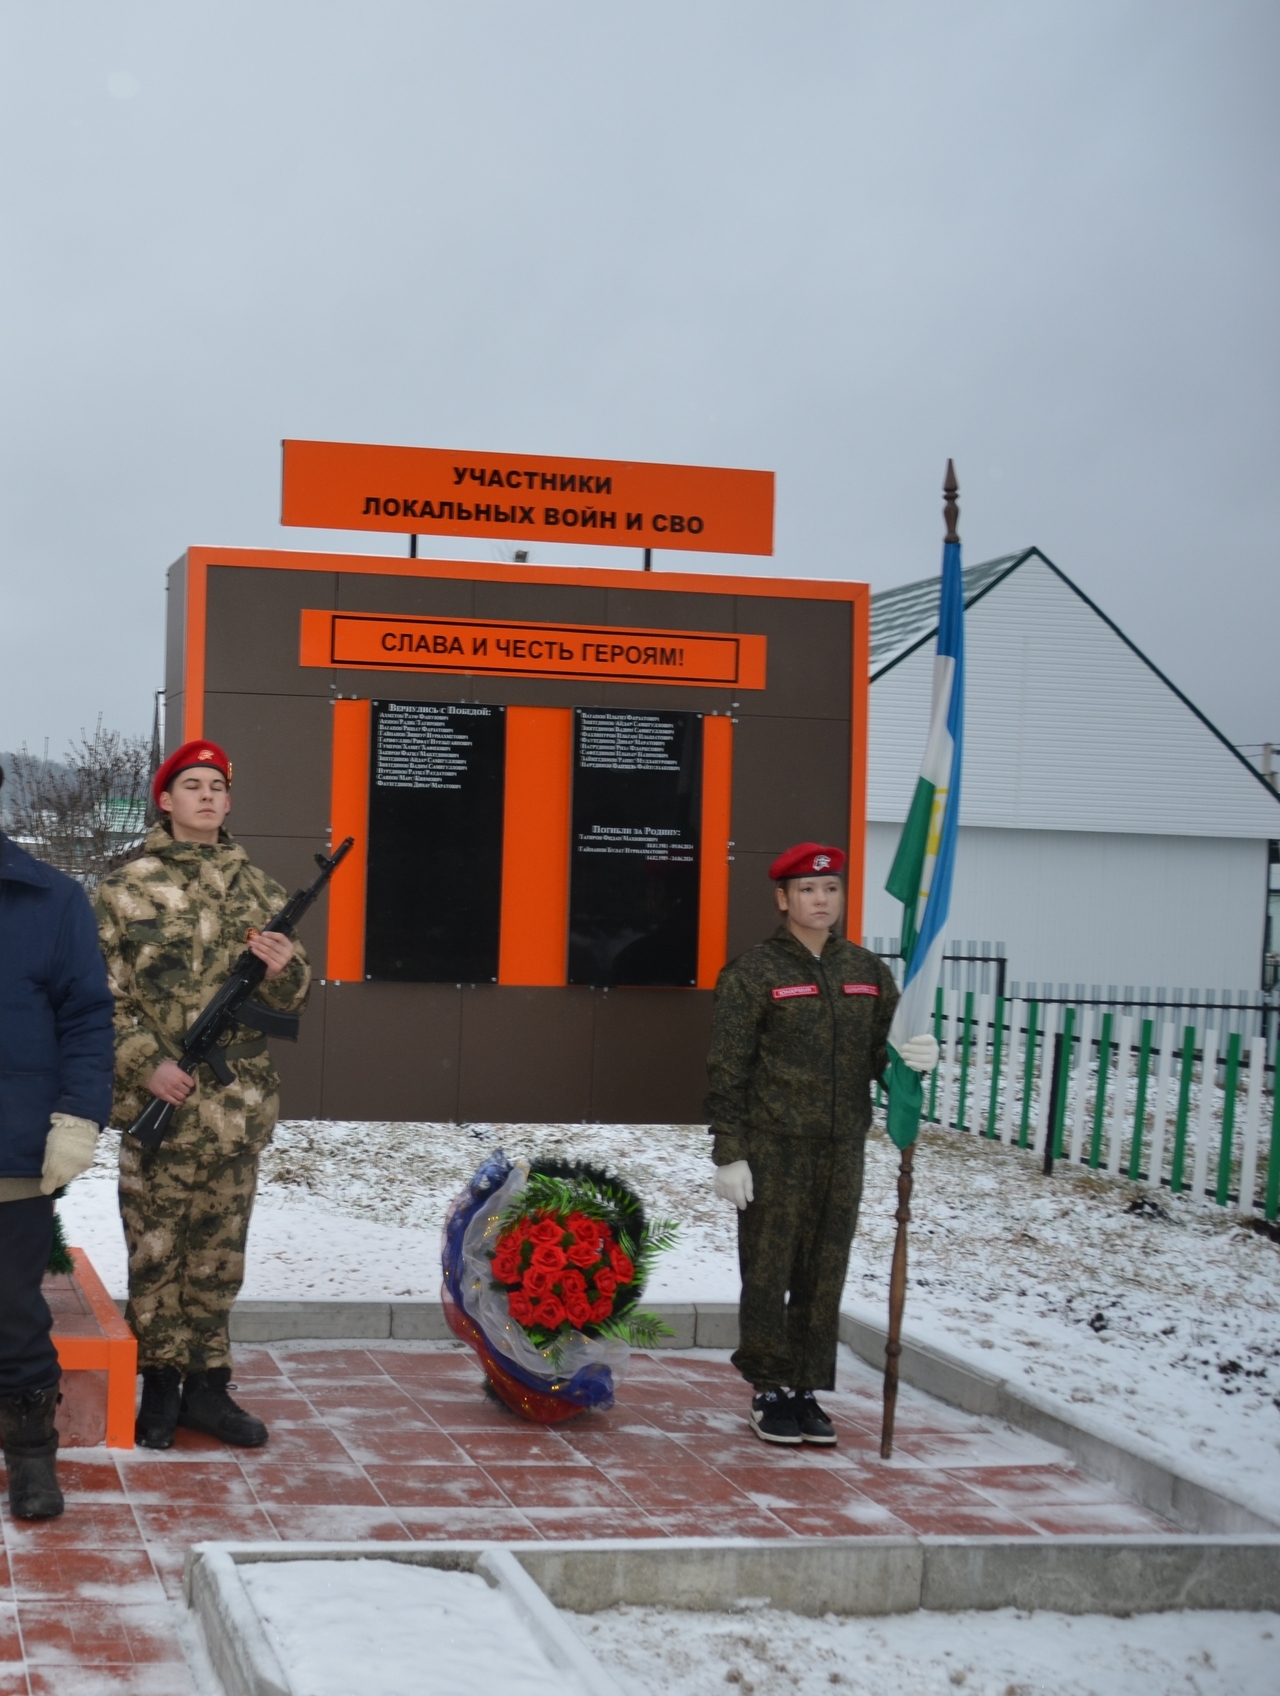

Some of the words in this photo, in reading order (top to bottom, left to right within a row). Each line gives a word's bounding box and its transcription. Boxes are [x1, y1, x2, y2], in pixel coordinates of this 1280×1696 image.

[453, 466, 612, 495] УЧАСТНИКИ
[362, 496, 535, 525] ЛОКАЛЬНЫХ
[544, 506, 617, 530] ВОЙН
[626, 512, 643, 531] И
[652, 513, 704, 535] СВО
[381, 632, 464, 655] СЛАВА
[473, 638, 487, 656] И
[496, 639, 574, 661] ЧЕСТЬ
[582, 643, 683, 666] ГЕРОЯМ!
